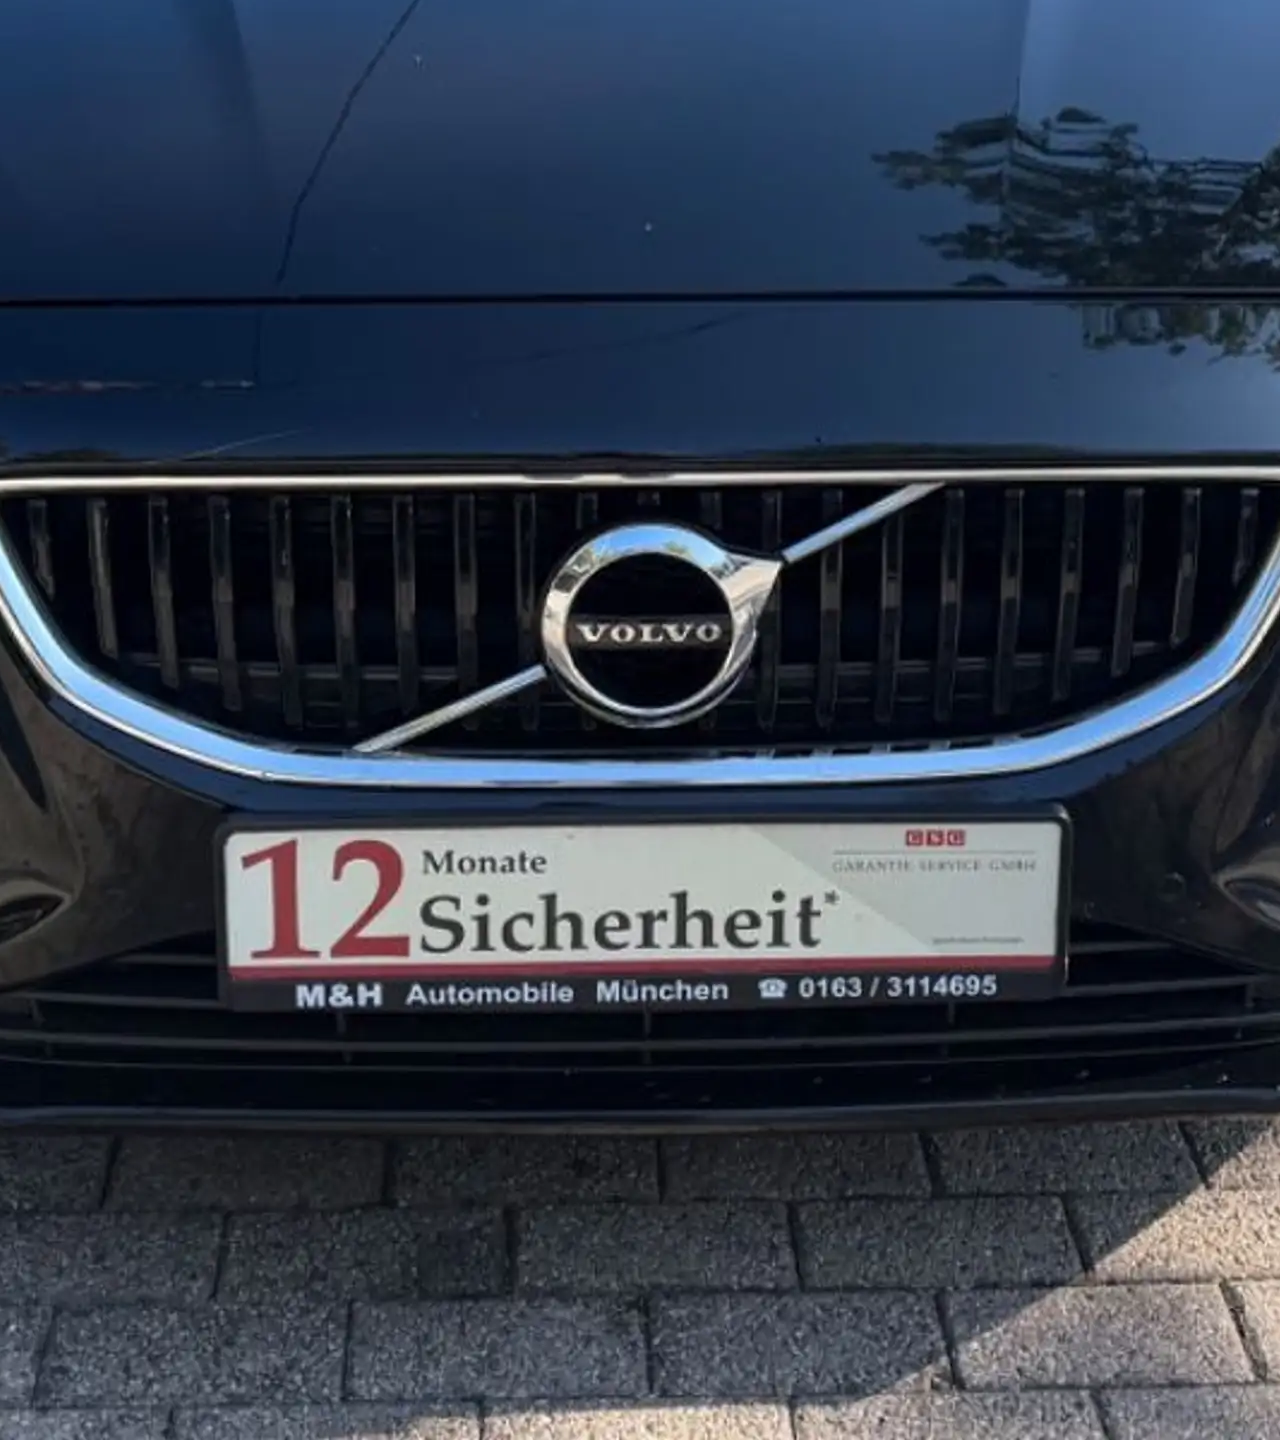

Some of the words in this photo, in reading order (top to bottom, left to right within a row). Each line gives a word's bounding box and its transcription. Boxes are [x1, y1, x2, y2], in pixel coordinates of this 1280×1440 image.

[577, 623, 722, 642] VOLVO
[422, 849, 548, 876] Monate
[241, 838, 411, 959] 12
[296, 984, 383, 1008] M&H
[405, 981, 574, 1006] Automobile
[597, 978, 729, 1003] München
[798, 976, 863, 999] 0163
[887, 975, 998, 998] 3114695
